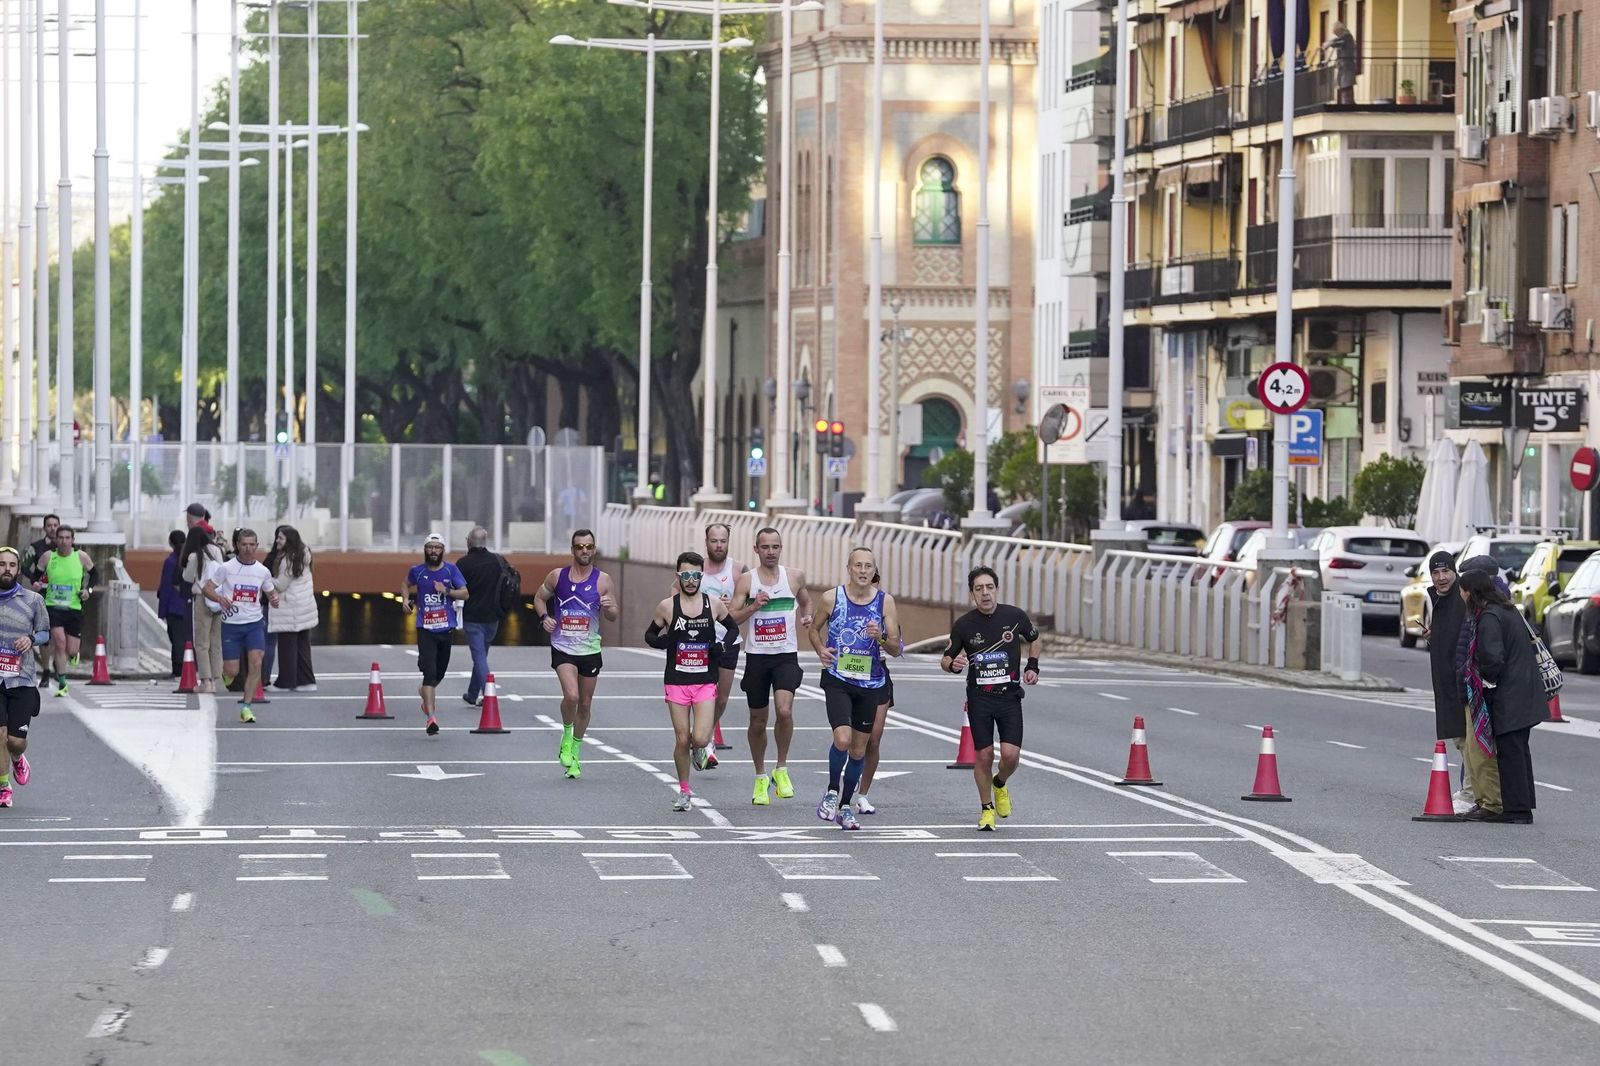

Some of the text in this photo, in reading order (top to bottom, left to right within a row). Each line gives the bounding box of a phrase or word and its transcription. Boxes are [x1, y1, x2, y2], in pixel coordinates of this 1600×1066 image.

[1417, 372, 1448, 382] LUIS
[1519, 391, 1577, 406] TINTE
[1290, 414, 1313, 444] P
[0, 662, 18, 672] TISTE
[680, 658, 704, 666] SERGIO
[844, 663, 865, 672] JESUS
[979, 668, 1006, 678] PANCHO
